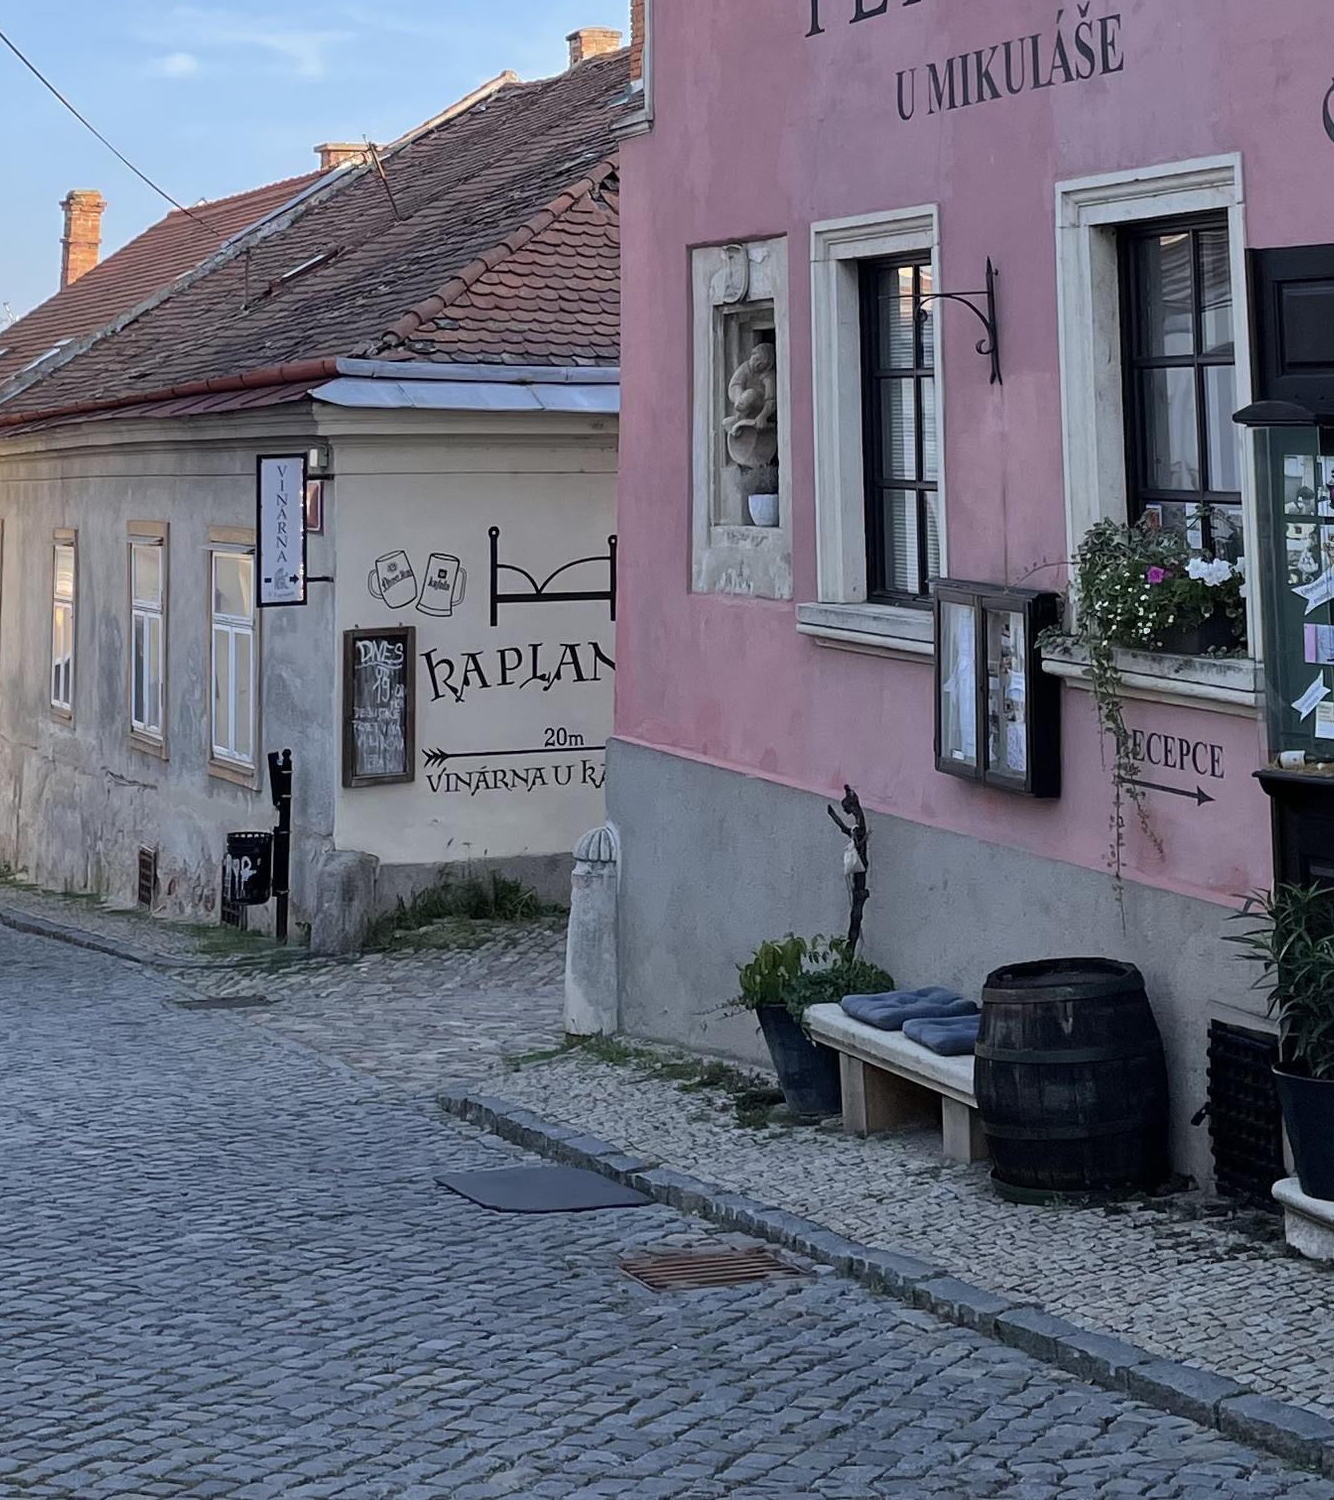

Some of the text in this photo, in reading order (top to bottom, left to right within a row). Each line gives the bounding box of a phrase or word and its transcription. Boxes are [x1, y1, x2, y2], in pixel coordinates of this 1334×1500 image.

[895, 0, 1124, 121] U MIKULÁŠE
[276, 465, 288, 563] VINÁRNA
[356, 640, 404, 664] DNES
[544, 727, 585, 747] 20m
[1116, 726, 1225, 779] ECEPCE
[426, 765, 548, 797] VINÁRNA
[552, 765, 575, 786] U
